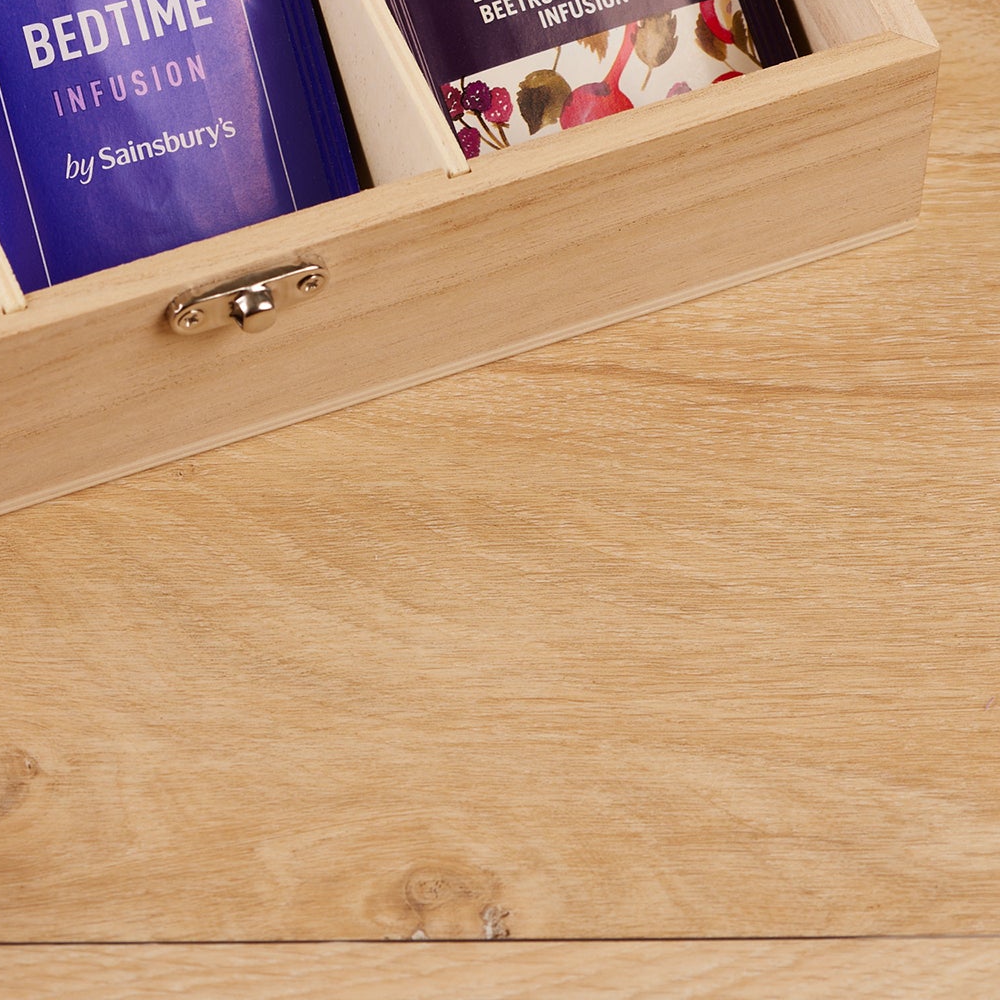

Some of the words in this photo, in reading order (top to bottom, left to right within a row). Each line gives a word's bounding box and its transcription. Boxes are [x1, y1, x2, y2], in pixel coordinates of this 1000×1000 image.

[52, 54, 207, 118] INFUSION
[65, 152, 97, 185] by
[98, 117, 237, 170] Sainsbury's
